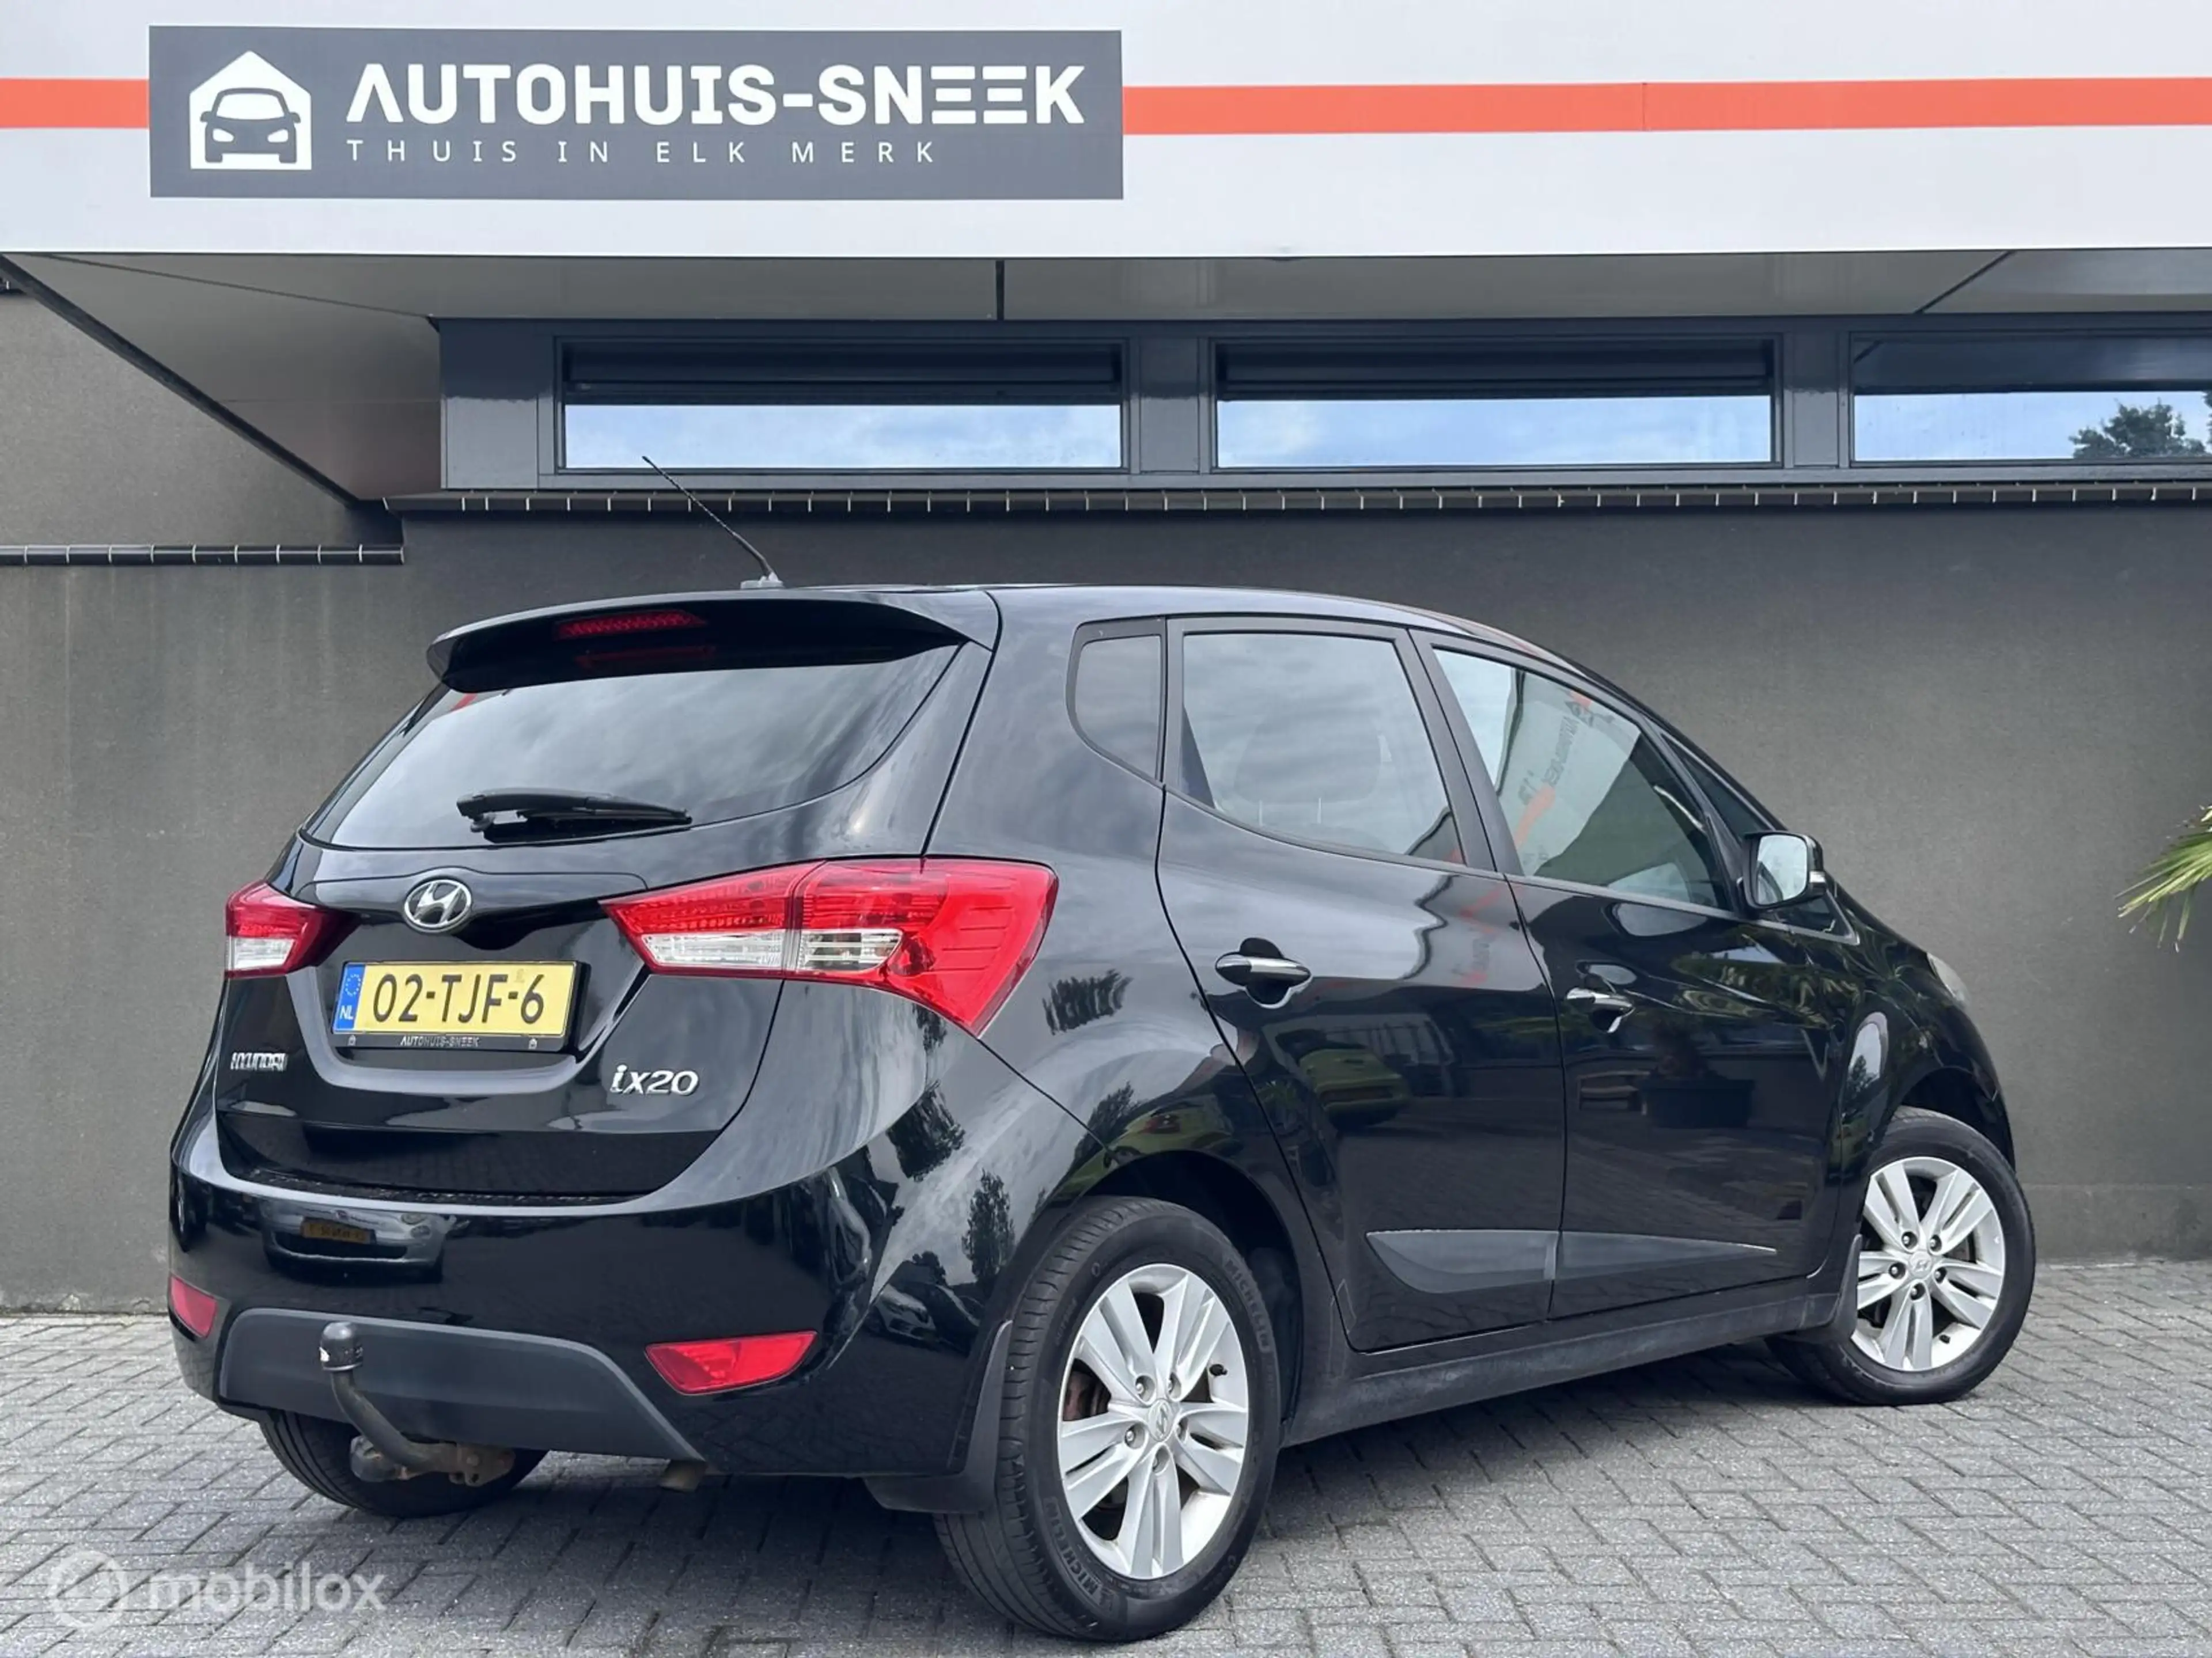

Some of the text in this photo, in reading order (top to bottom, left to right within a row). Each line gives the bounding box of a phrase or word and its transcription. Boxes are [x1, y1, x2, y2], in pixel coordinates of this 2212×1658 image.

[346, 63, 1085, 126] AUTOHUIS-SNEEK
[346, 139, 934, 164] THUIS IN ELK MERK
[340, 1004, 354, 1020] NL
[373, 973, 545, 1025] 02-TJF-6
[400, 1035, 480, 1048] AUTOHUIS-SNEEK
[609, 1064, 699, 1096] ix20
